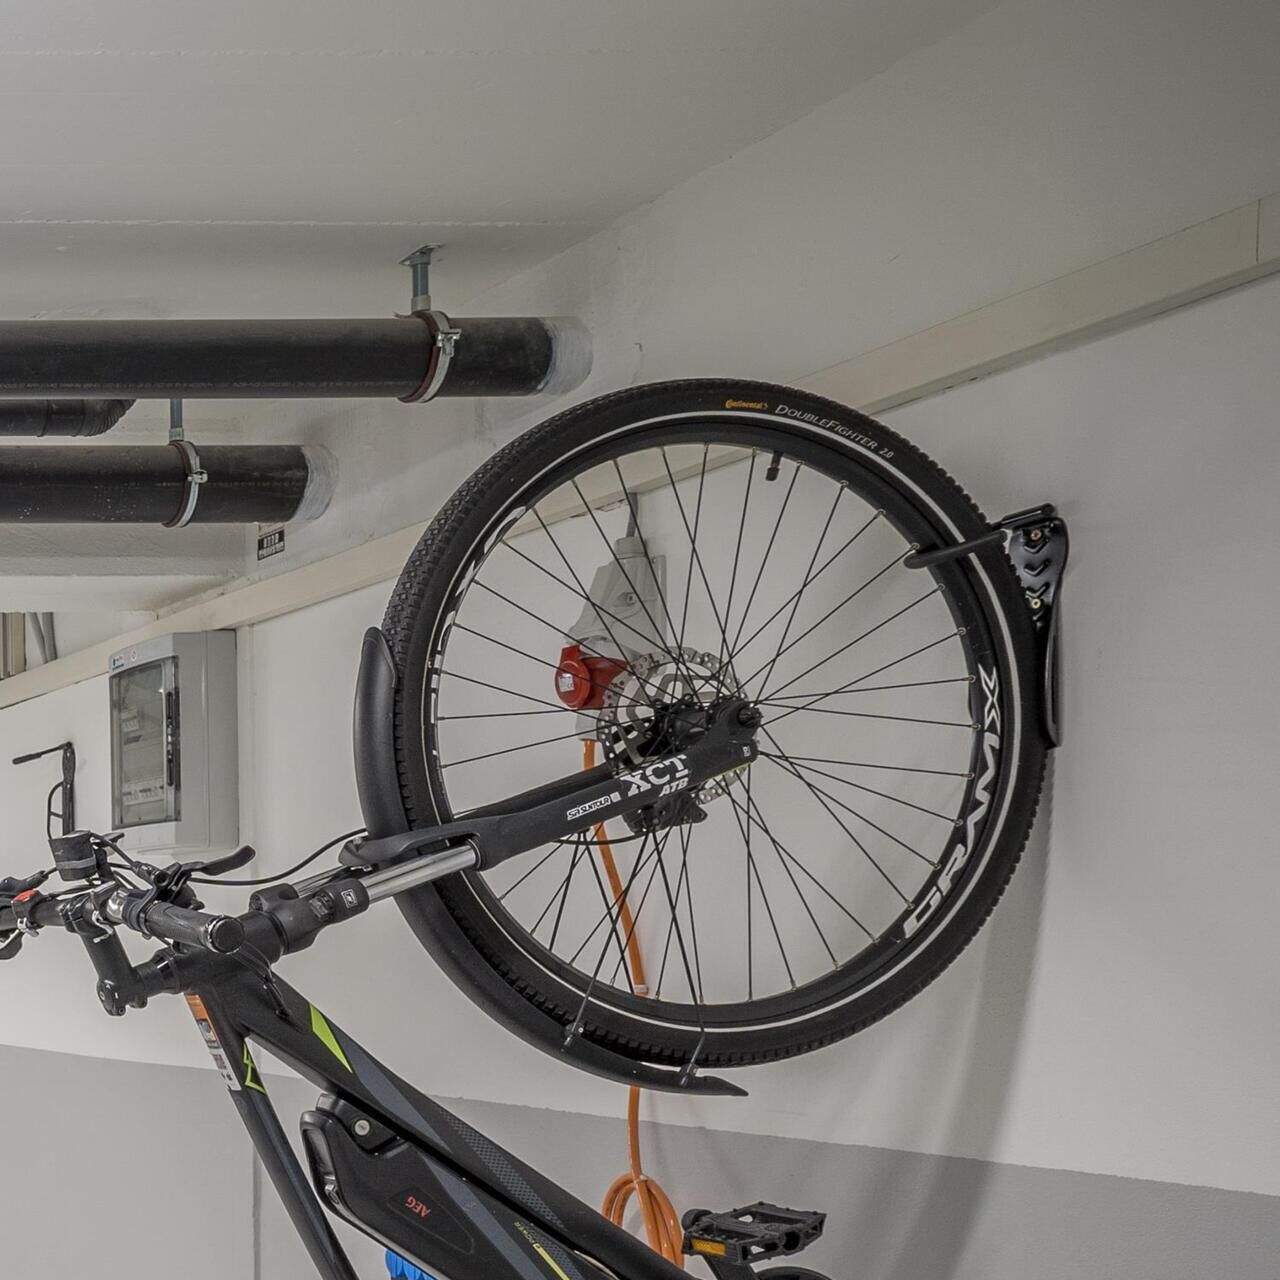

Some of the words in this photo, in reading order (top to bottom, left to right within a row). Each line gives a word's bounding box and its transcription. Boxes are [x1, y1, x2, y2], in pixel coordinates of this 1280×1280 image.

[620, 754, 689, 798] XCT
[658, 777, 689, 798] ATB
[405, 1196, 432, 1217] AEG
